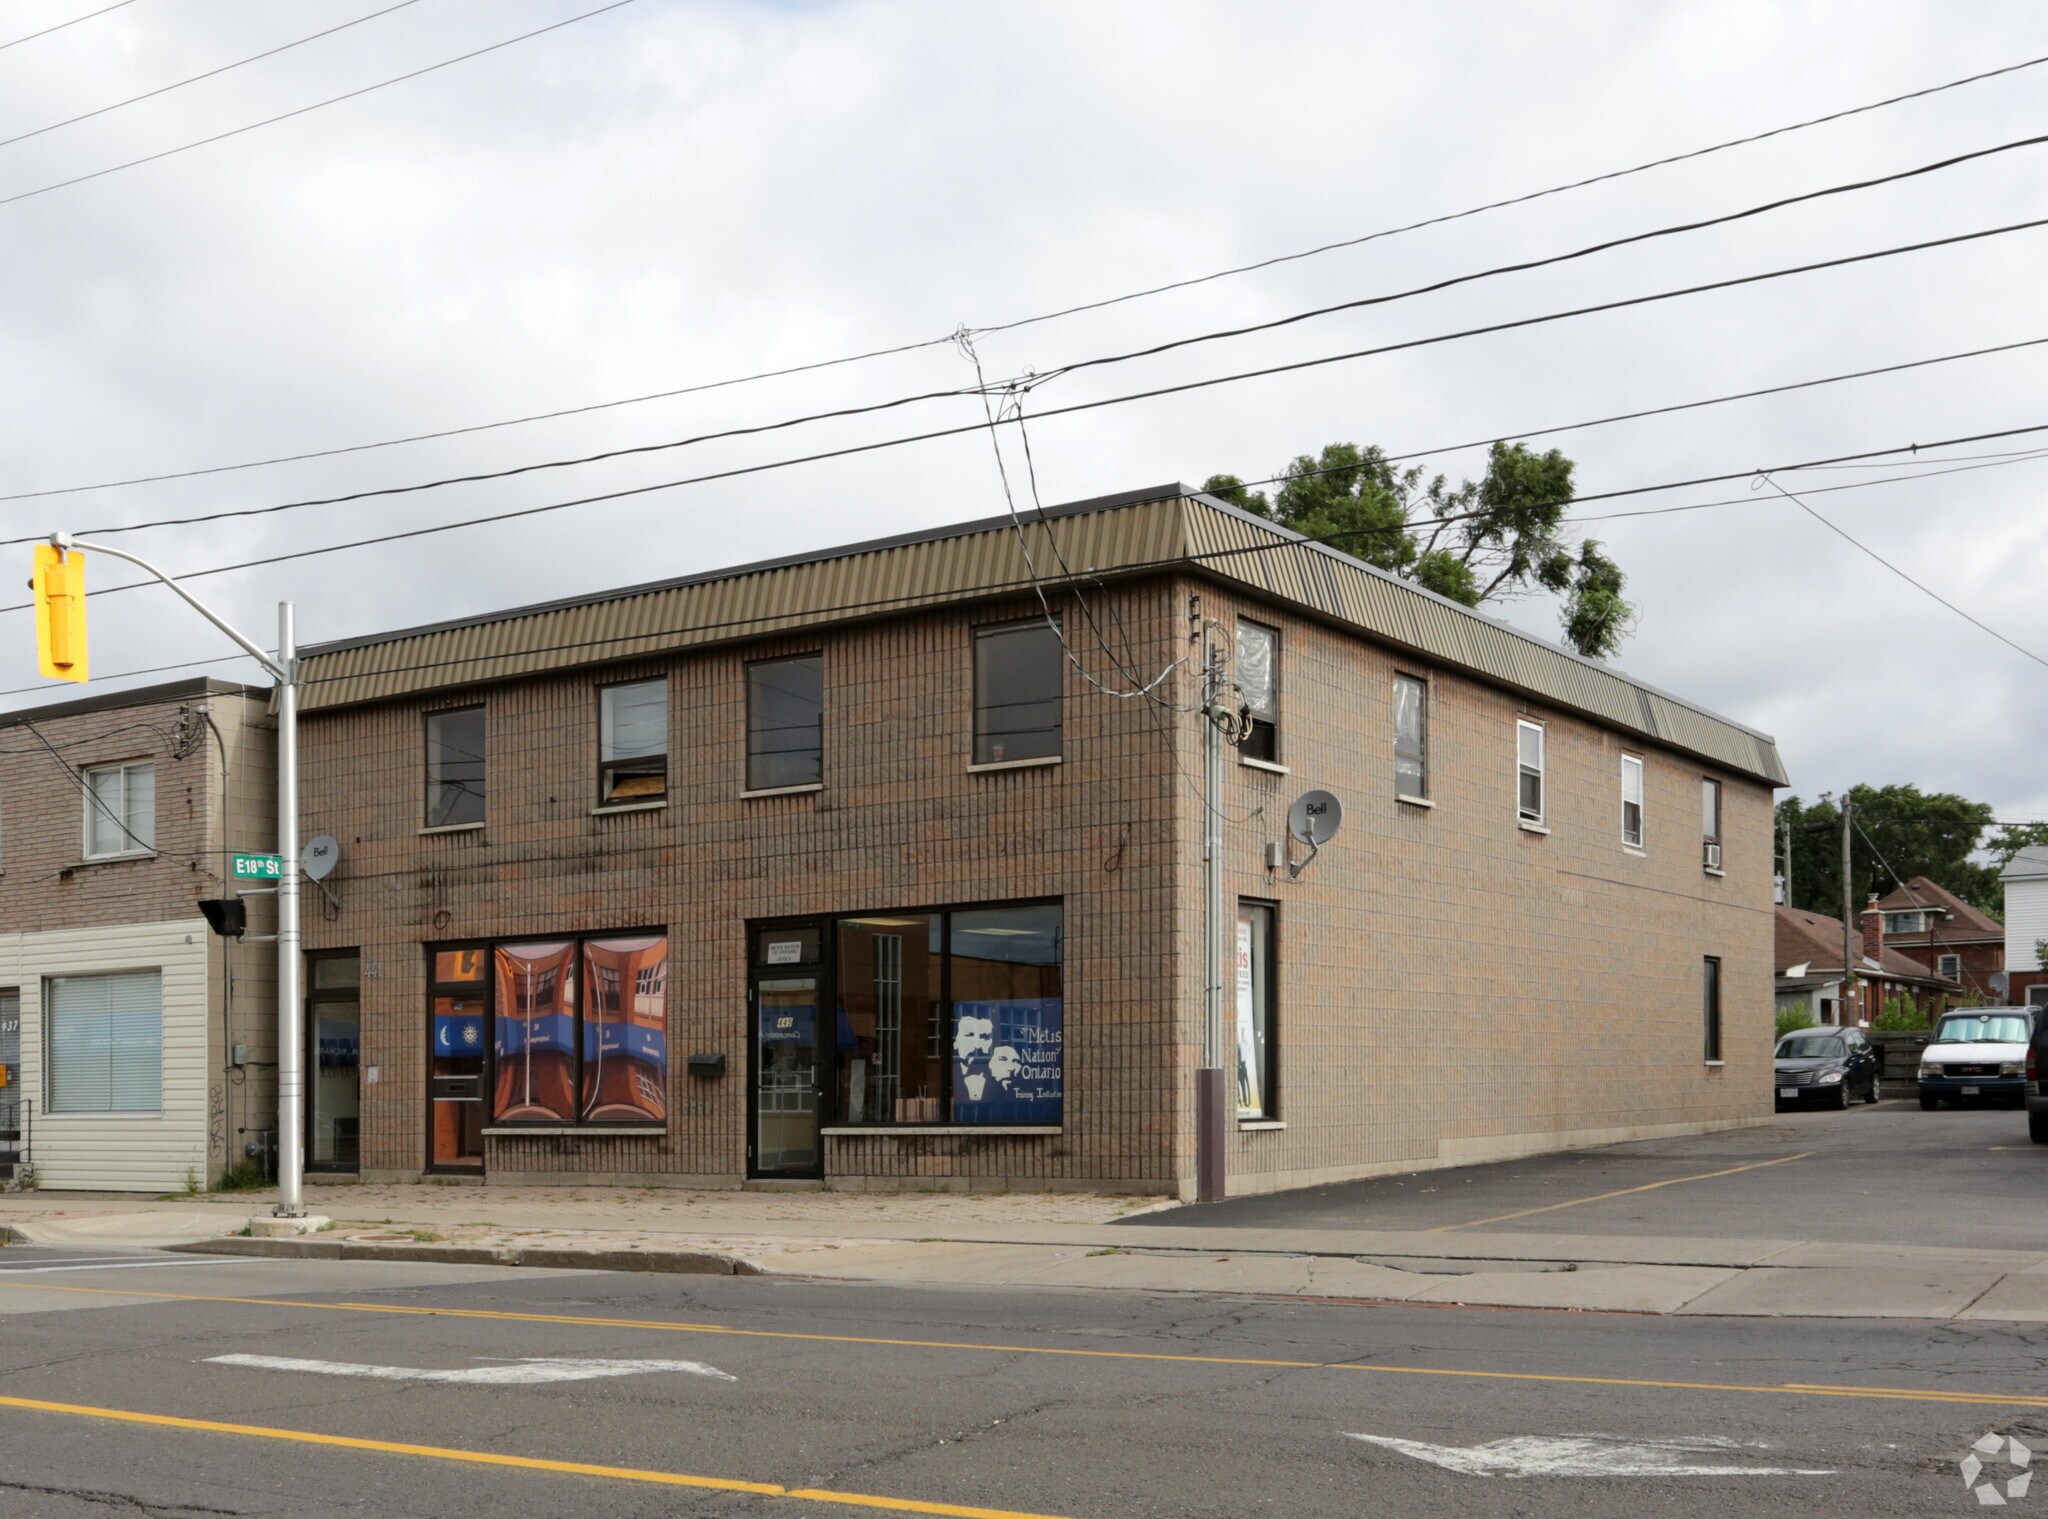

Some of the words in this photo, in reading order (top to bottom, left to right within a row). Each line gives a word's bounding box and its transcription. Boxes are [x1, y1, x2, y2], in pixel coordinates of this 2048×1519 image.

[1306, 802, 1327, 815] Bell
[313, 846, 328, 857] Bell
[266, 860, 280, 875] St
[364, 962, 384, 978] 441
[1, 1020, 18, 1032] 437
[1021, 1048, 1057, 1063] Nation
[1021, 1065, 1061, 1079] Ontario
